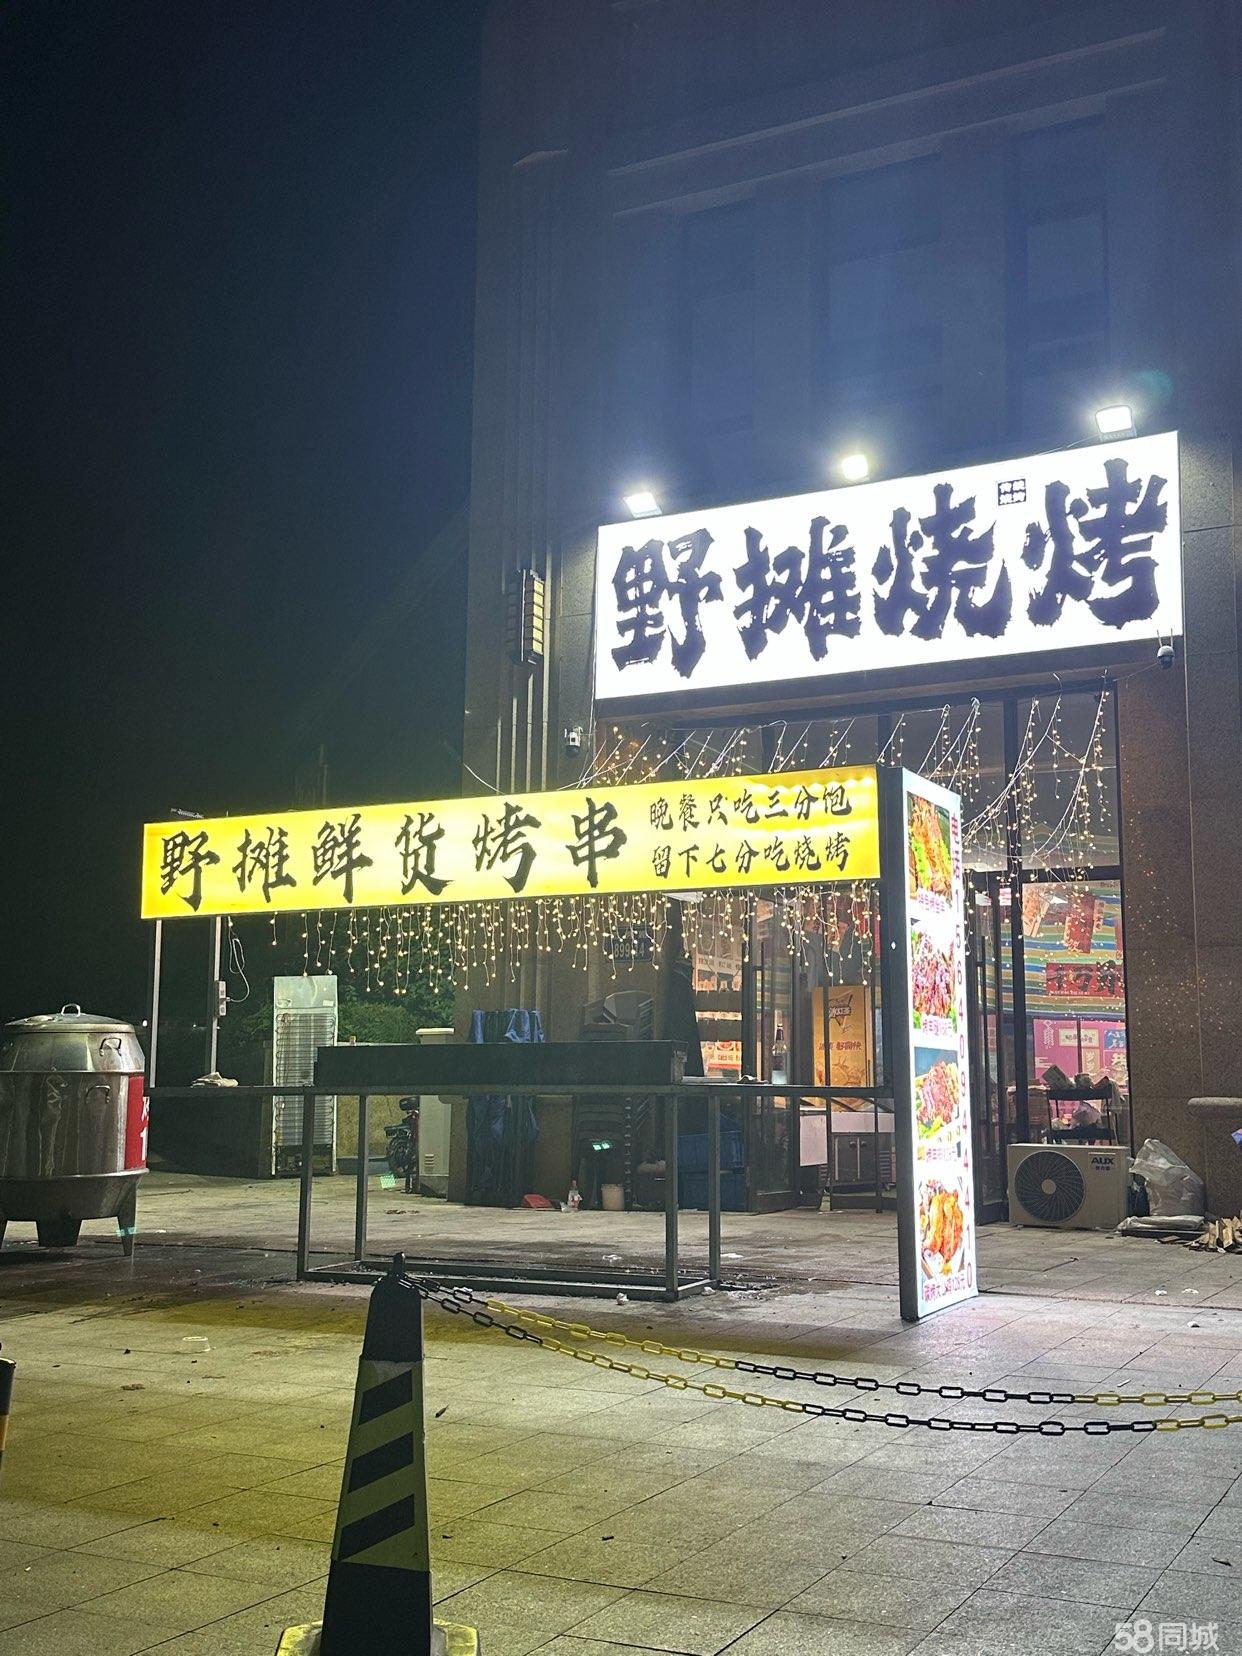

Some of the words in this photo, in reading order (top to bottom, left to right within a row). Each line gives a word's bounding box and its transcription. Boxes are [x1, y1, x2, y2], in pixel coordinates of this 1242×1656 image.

[612, 458, 1168, 678] 野摊烧烤
[650, 784, 852, 832] 晚餐只吃三分饱
[160, 797, 627, 911] 野摊鲜货烤串
[651, 831, 851, 879] 留下七分吃烧烤
[1091, 1157, 1114, 1165] AUX
